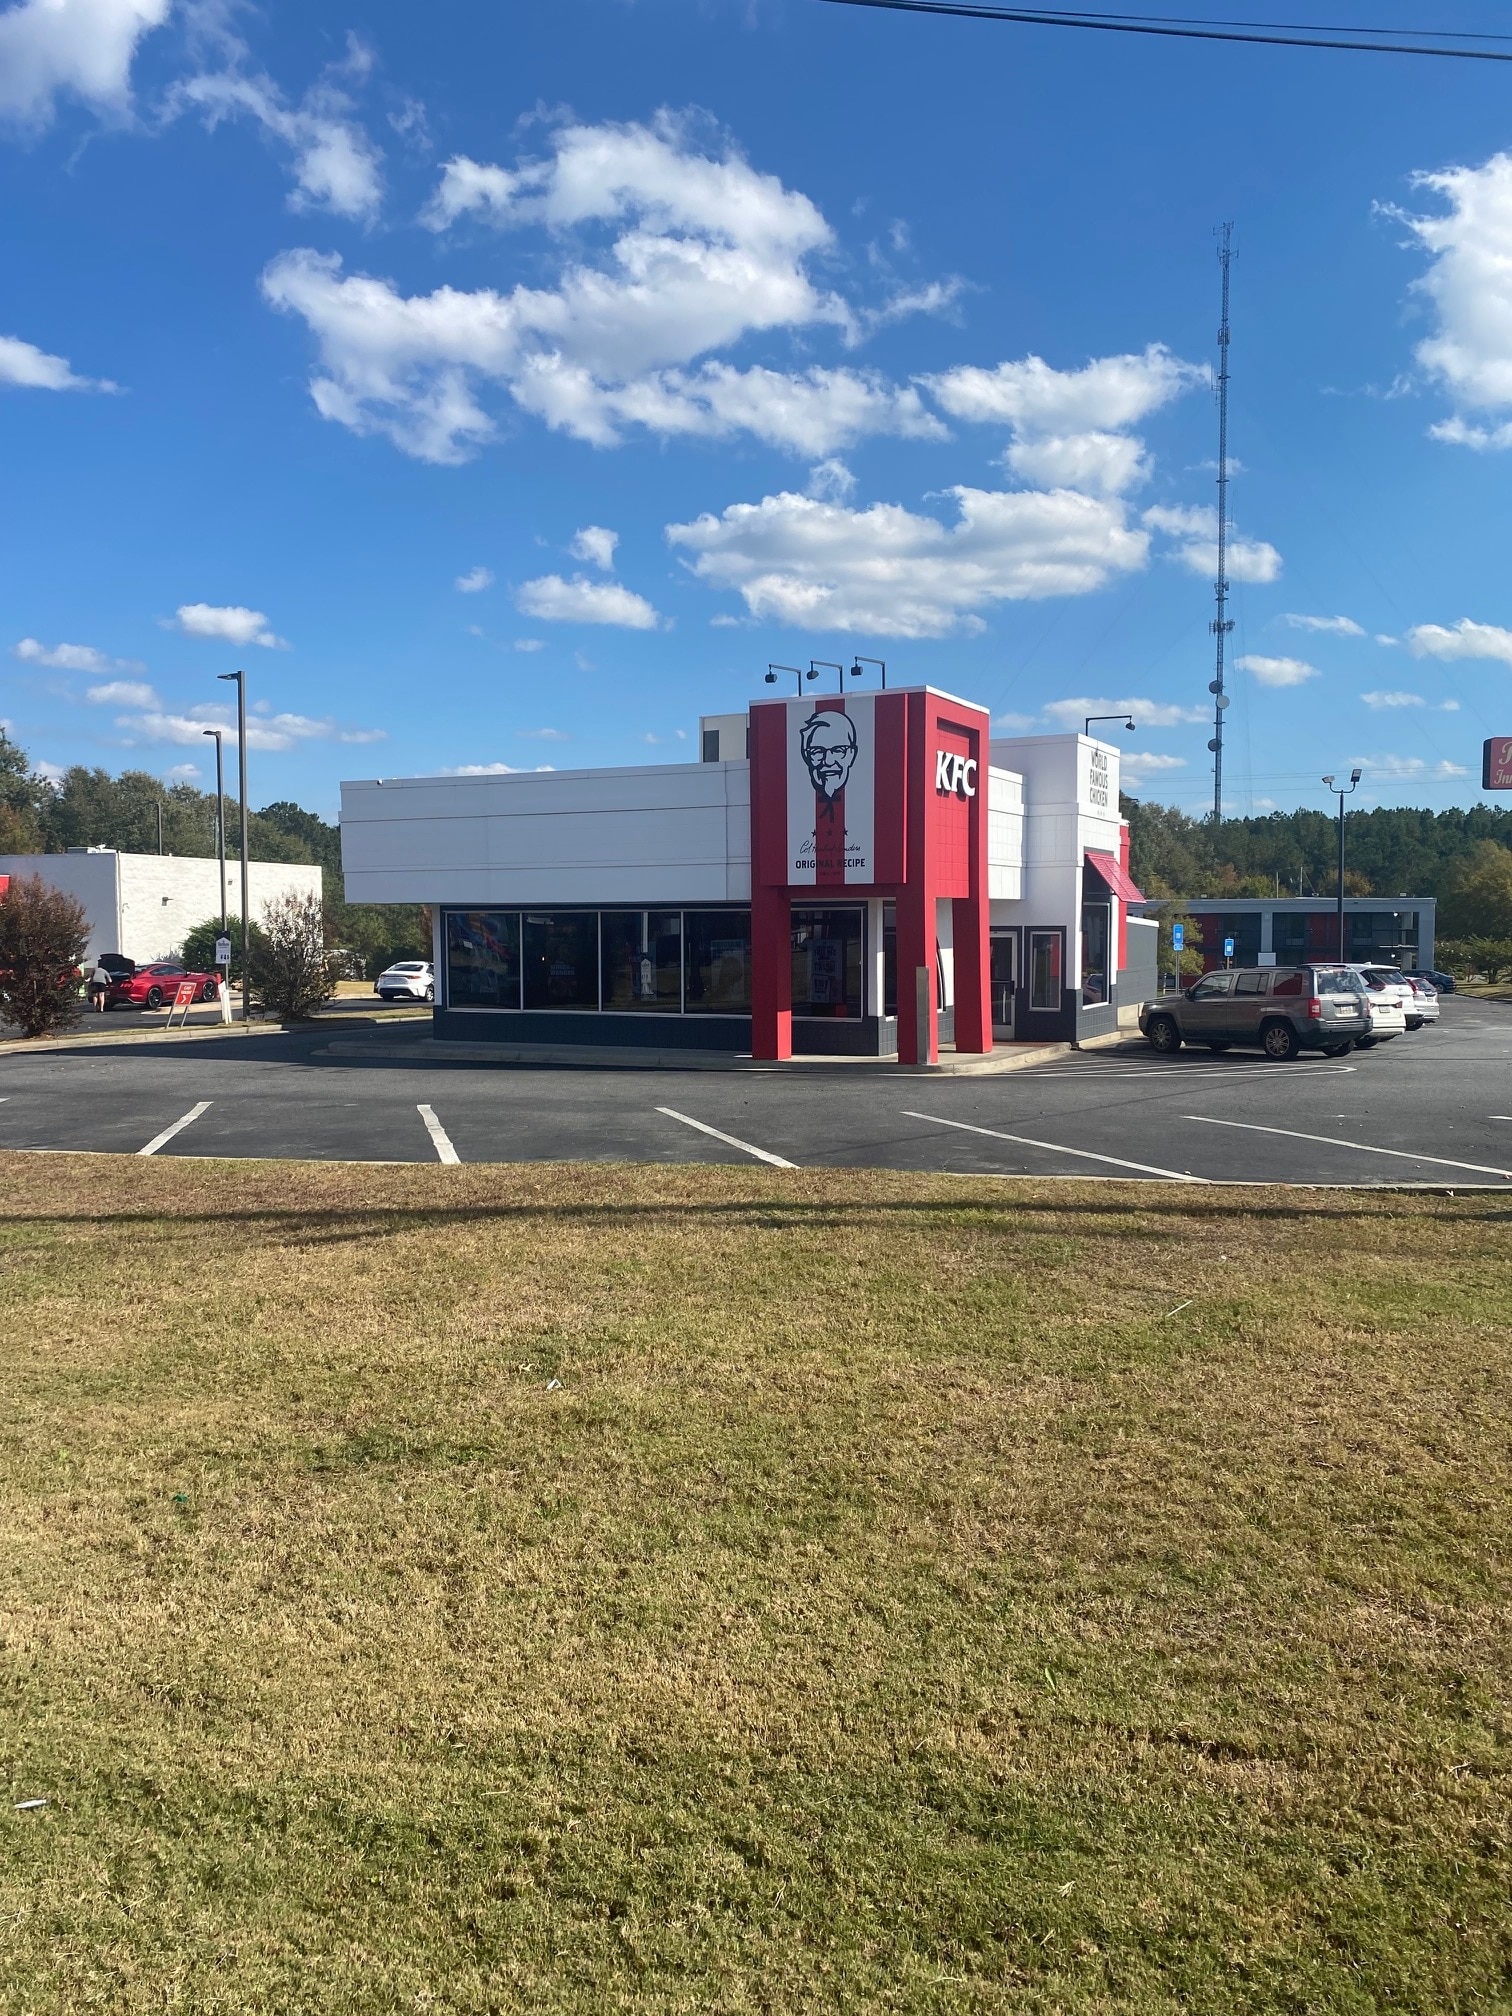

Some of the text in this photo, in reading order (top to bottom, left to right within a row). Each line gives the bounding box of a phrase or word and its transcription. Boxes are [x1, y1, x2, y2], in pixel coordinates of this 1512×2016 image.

[1091, 750, 1107, 771] WORLD
[936, 750, 977, 796] KFC
[1090, 769, 1108, 789] FAMOUS
[1090, 787, 1108, 807] CHICKEN
[796, 858, 866, 869] ORIGINAL RECIPE
